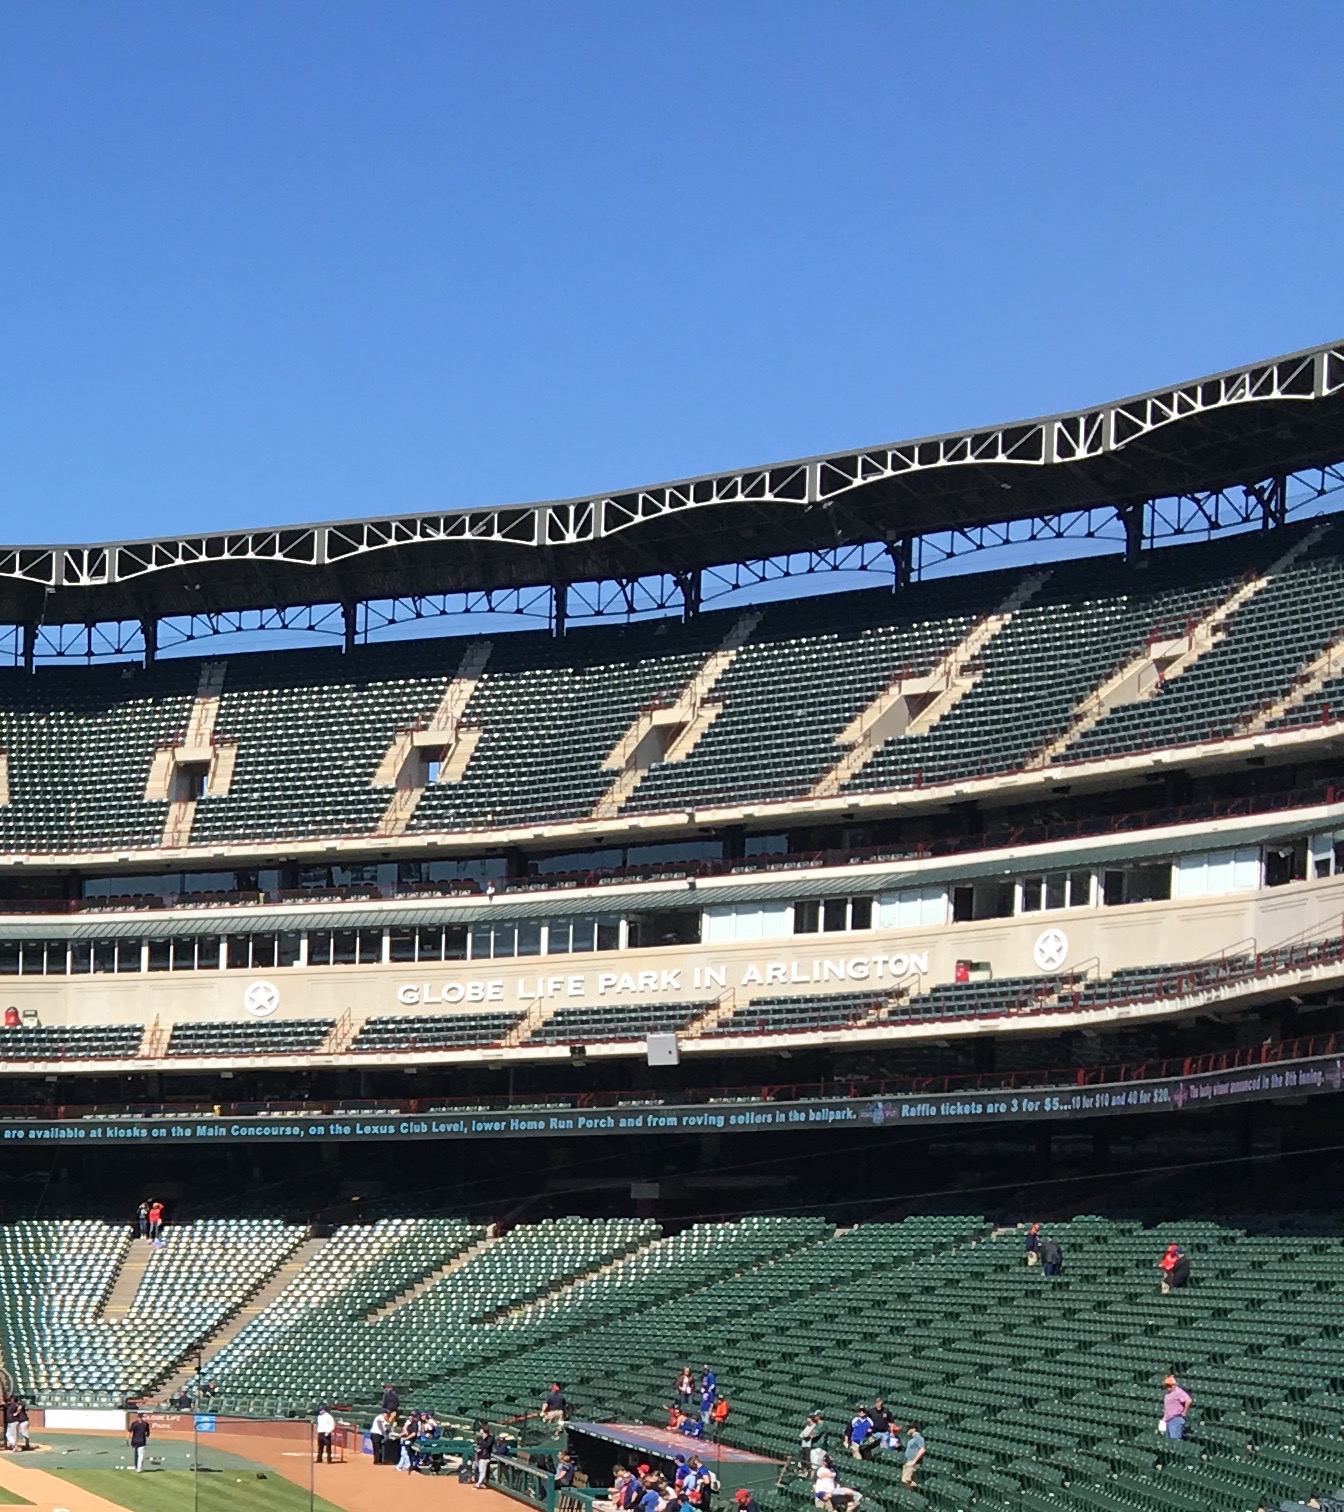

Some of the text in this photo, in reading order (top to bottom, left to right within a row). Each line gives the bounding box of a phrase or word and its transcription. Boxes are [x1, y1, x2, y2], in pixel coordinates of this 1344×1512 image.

[397, 951, 930, 1004] GLOBE LIFE PARK IN ARLINGTON
[902, 1103, 937, 1117] Raffle
[941, 1101, 983, 1116] tickets
[986, 1102, 1008, 1113] are
[1011, 1100, 1018, 1112] 3
[1022, 1098, 1040, 1112] for
[1095, 1093, 1110, 1108] $10
[4, 1130, 24, 1139] are
[28, 1128, 86, 1138] available
[90, 1128, 102, 1138] at
[106, 1127, 148, 1138] kiosks
[152, 1128, 166, 1137] on
[171, 1126, 192, 1137] the
[196, 1125, 226, 1136] Main
[231, 1124, 304, 1137] Concourse,
[309, 1126, 324, 1135] on
[329, 1124, 351, 1134] the
[356, 1123, 395, 1134] Lexus
[400, 1122, 428, 1134] Club
[432, 1120, 468, 1134] Level,
[472, 1120, 506, 1132] lower
[510, 1118, 545, 1130] Home
[550, 1118, 574, 1129] Run
[578, 1116, 614, 1128] Porch
[619, 1115, 642, 1127] and
[647, 1114, 678, 1126] from
[682, 1113, 724, 1128] roving
[729, 1112, 772, 1124] sellers
[776, 1110, 786, 1123] in
[789, 1110, 806, 1122] the
[809, 1108, 857, 1123] ballpark.
